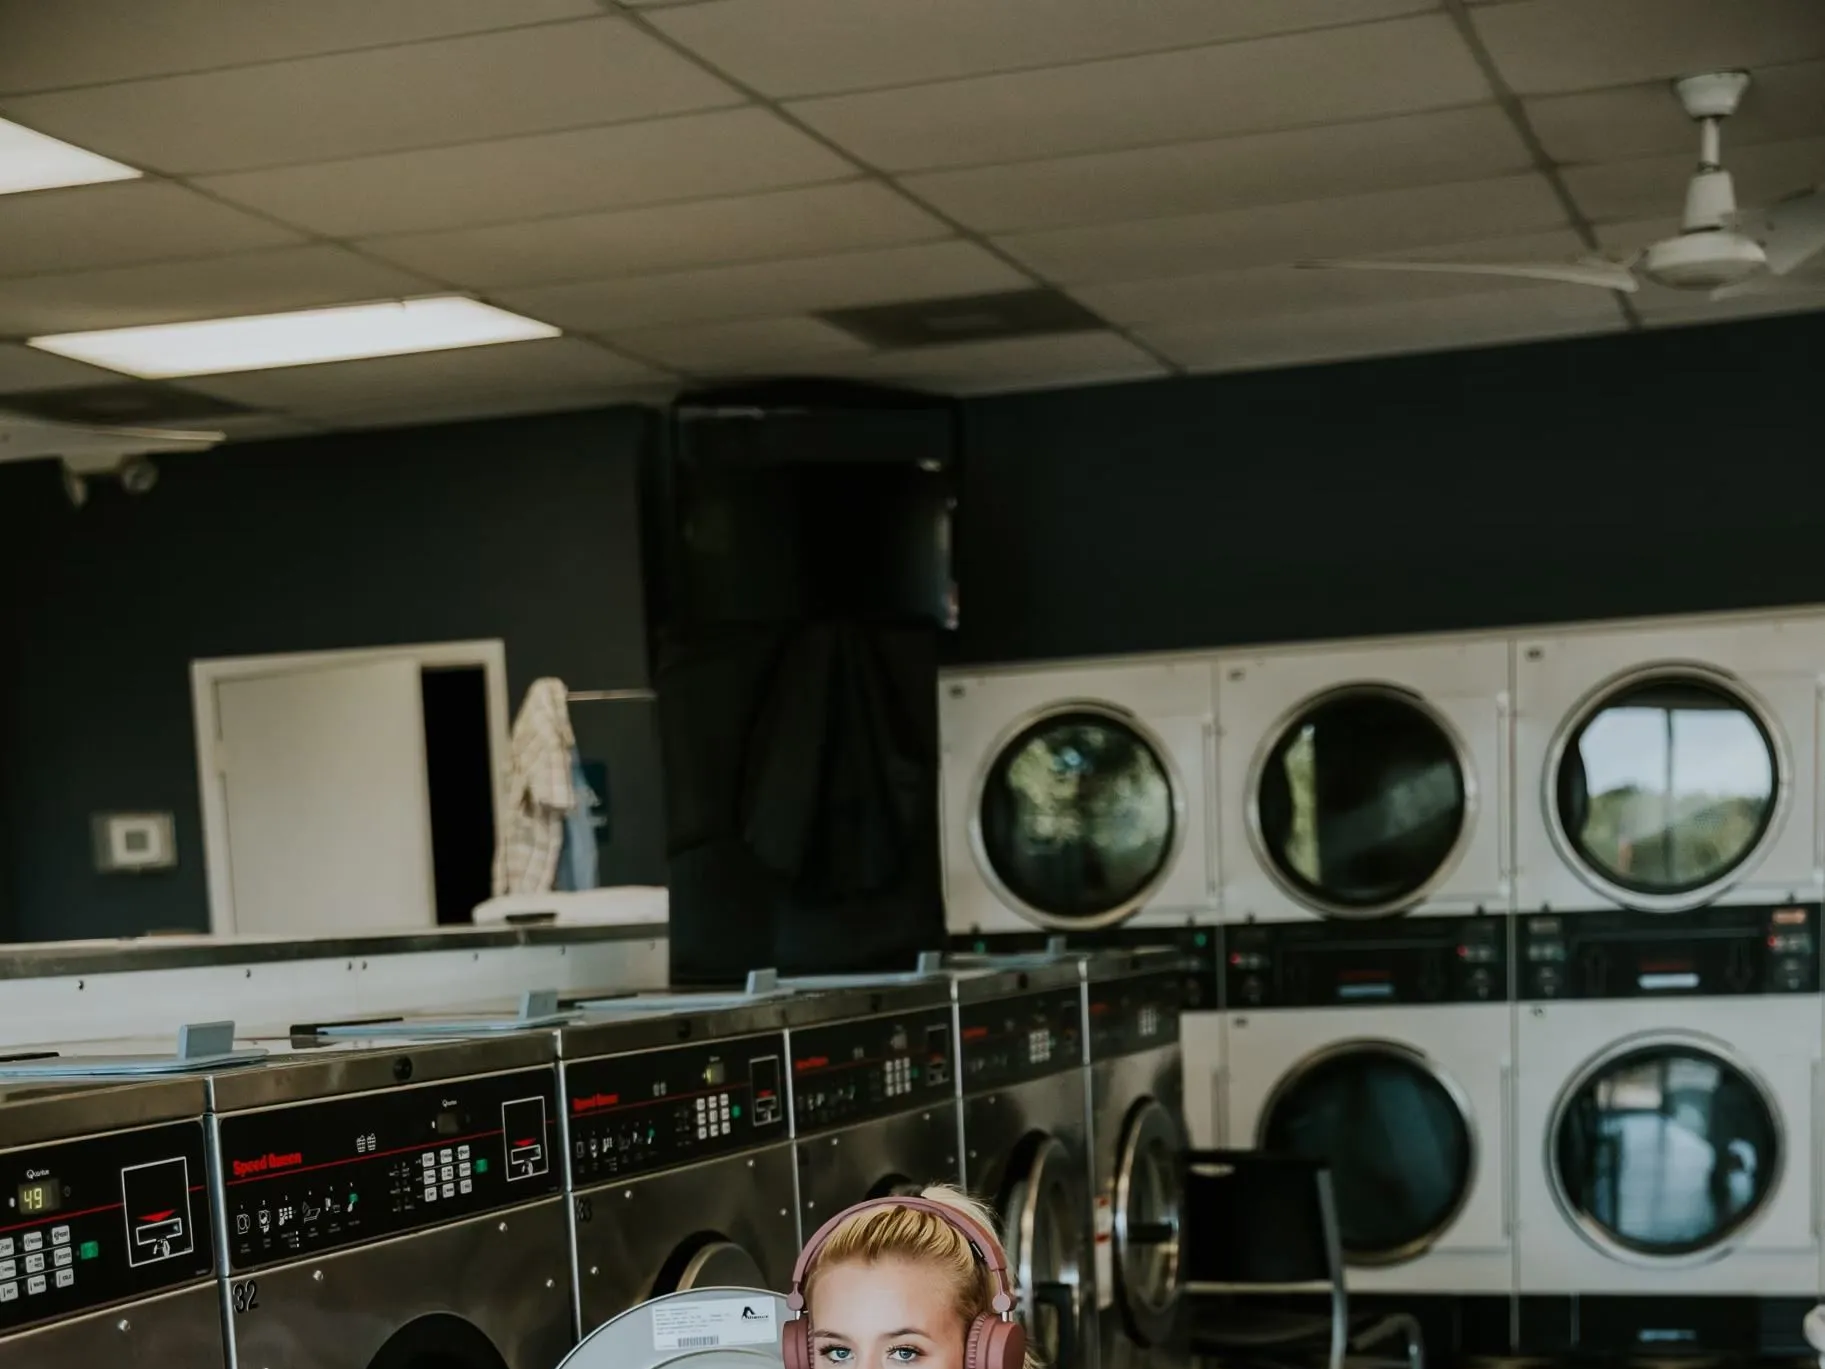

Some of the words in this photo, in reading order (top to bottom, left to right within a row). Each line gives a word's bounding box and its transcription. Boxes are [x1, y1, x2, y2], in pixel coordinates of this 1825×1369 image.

[233, 1155, 267, 1176] Speed
[268, 1152, 302, 1169] Queen
[24, 1187, 42, 1210] 49
[233, 1280, 259, 1313] 32
